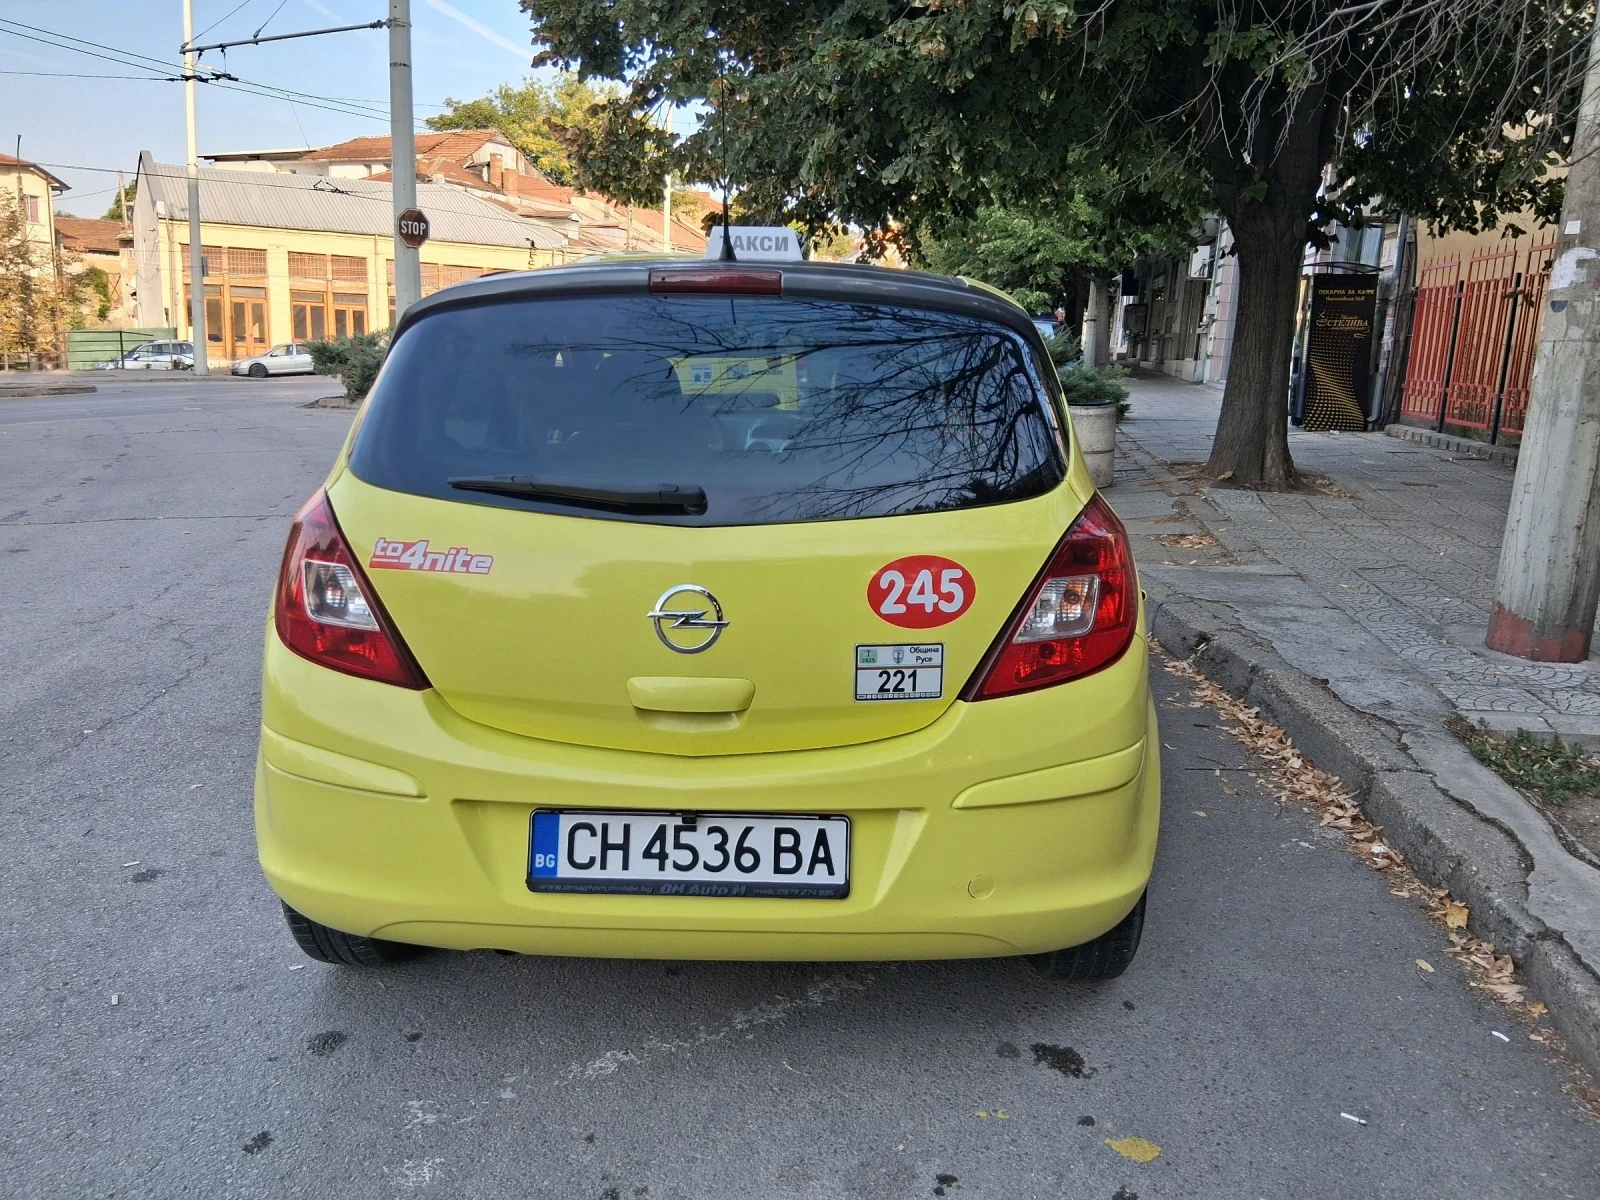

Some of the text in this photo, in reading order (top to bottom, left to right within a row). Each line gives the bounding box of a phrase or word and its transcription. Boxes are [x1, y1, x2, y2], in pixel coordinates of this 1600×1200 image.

[401, 220, 427, 236] STOP
[719, 235, 789, 252] АКСИ
[374, 538, 494, 574] to4nite
[879, 568, 965, 615] 245
[909, 646, 940, 654] Община
[916, 656, 933, 664] Русе
[878, 670, 918, 693] 221
[642, 823, 761, 873] 4536
[535, 853, 556, 868] BG
[660, 883, 747, 896] DM Auto M
